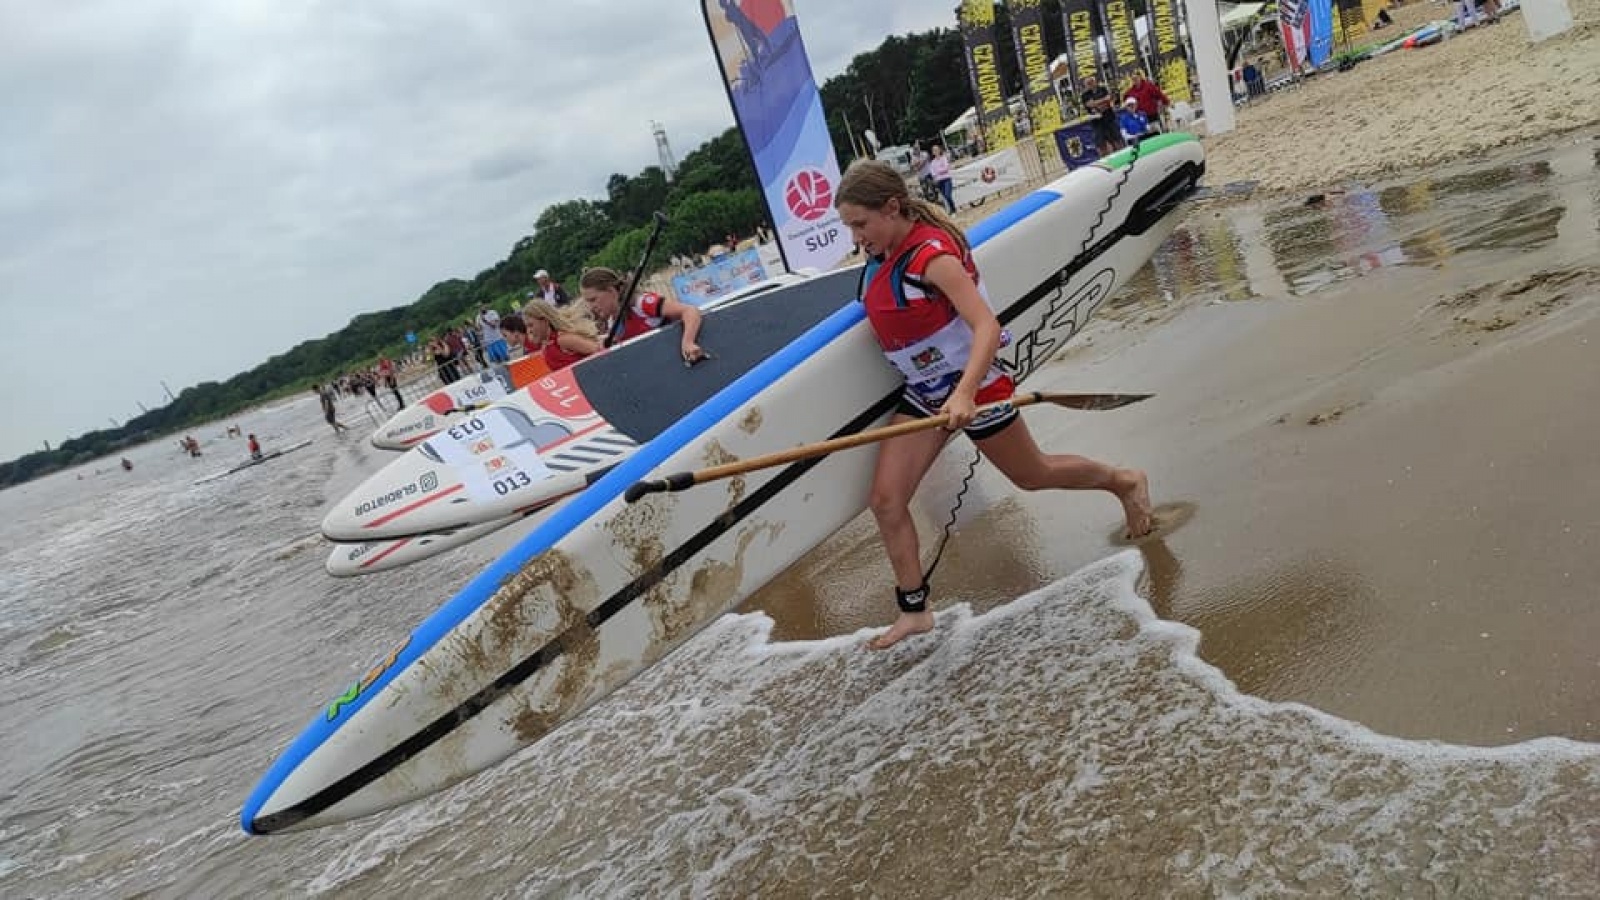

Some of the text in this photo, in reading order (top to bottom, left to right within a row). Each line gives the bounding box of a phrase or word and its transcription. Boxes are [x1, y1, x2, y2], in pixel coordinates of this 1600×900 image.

[805, 228, 838, 252] SUP
[447, 418, 486, 440] 013
[493, 471, 531, 496] 013
[354, 482, 418, 516] GLADIATOR
